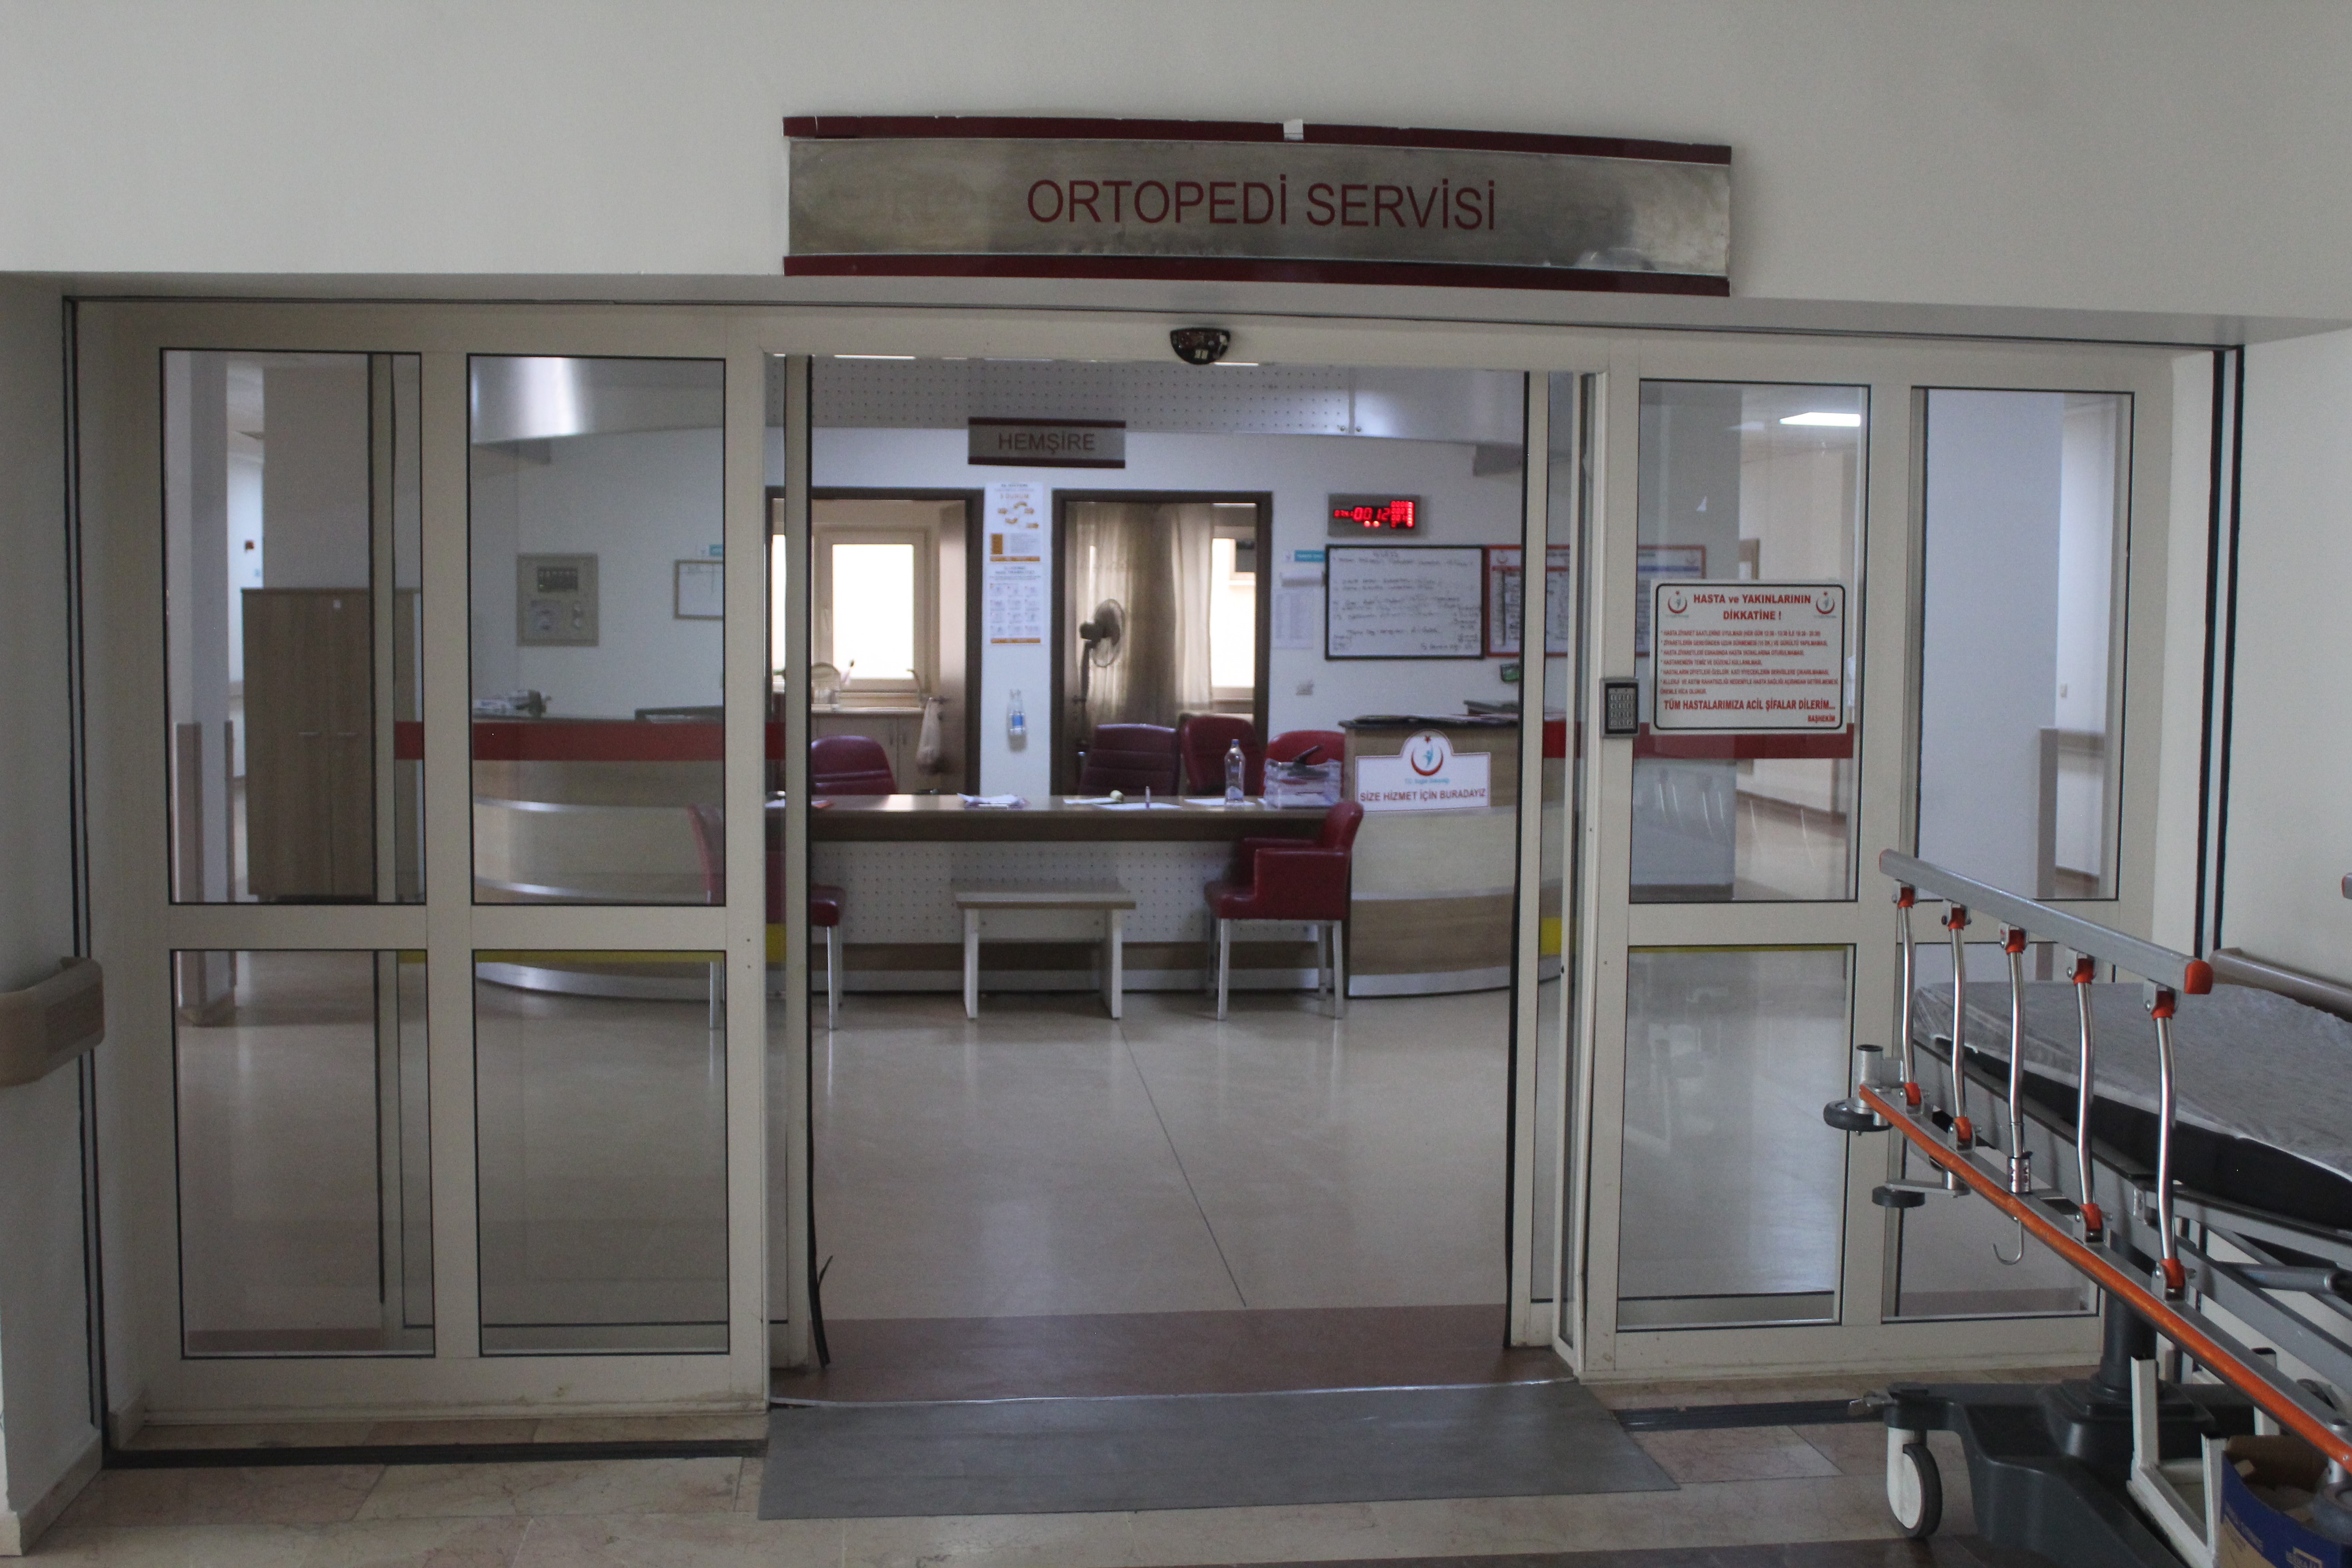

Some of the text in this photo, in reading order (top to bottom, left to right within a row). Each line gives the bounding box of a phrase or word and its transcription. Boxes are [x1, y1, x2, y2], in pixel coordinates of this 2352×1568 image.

[1027, 174, 1495, 230] ORTOPEDİ SERVİSİ
[998, 430, 1096, 454] HEMŞİRE
[1693, 594, 1725, 604] HASTA
[1743, 594, 1811, 604] YAKINLARININ
[1723, 609, 1782, 620] DİKKATİNE !
[1664, 699, 1681, 710] TÜM
[1683, 699, 1744, 710] HASTALARIMIZA
[1746, 697, 1764, 710] ACİL
[1765, 697, 1796, 712] ŞİFALAR
[1807, 714, 1836, 724] BAŞHEKİM
[1360, 788, 1486, 802] SİZE HİZMET İÇİN BURADAYIZ
